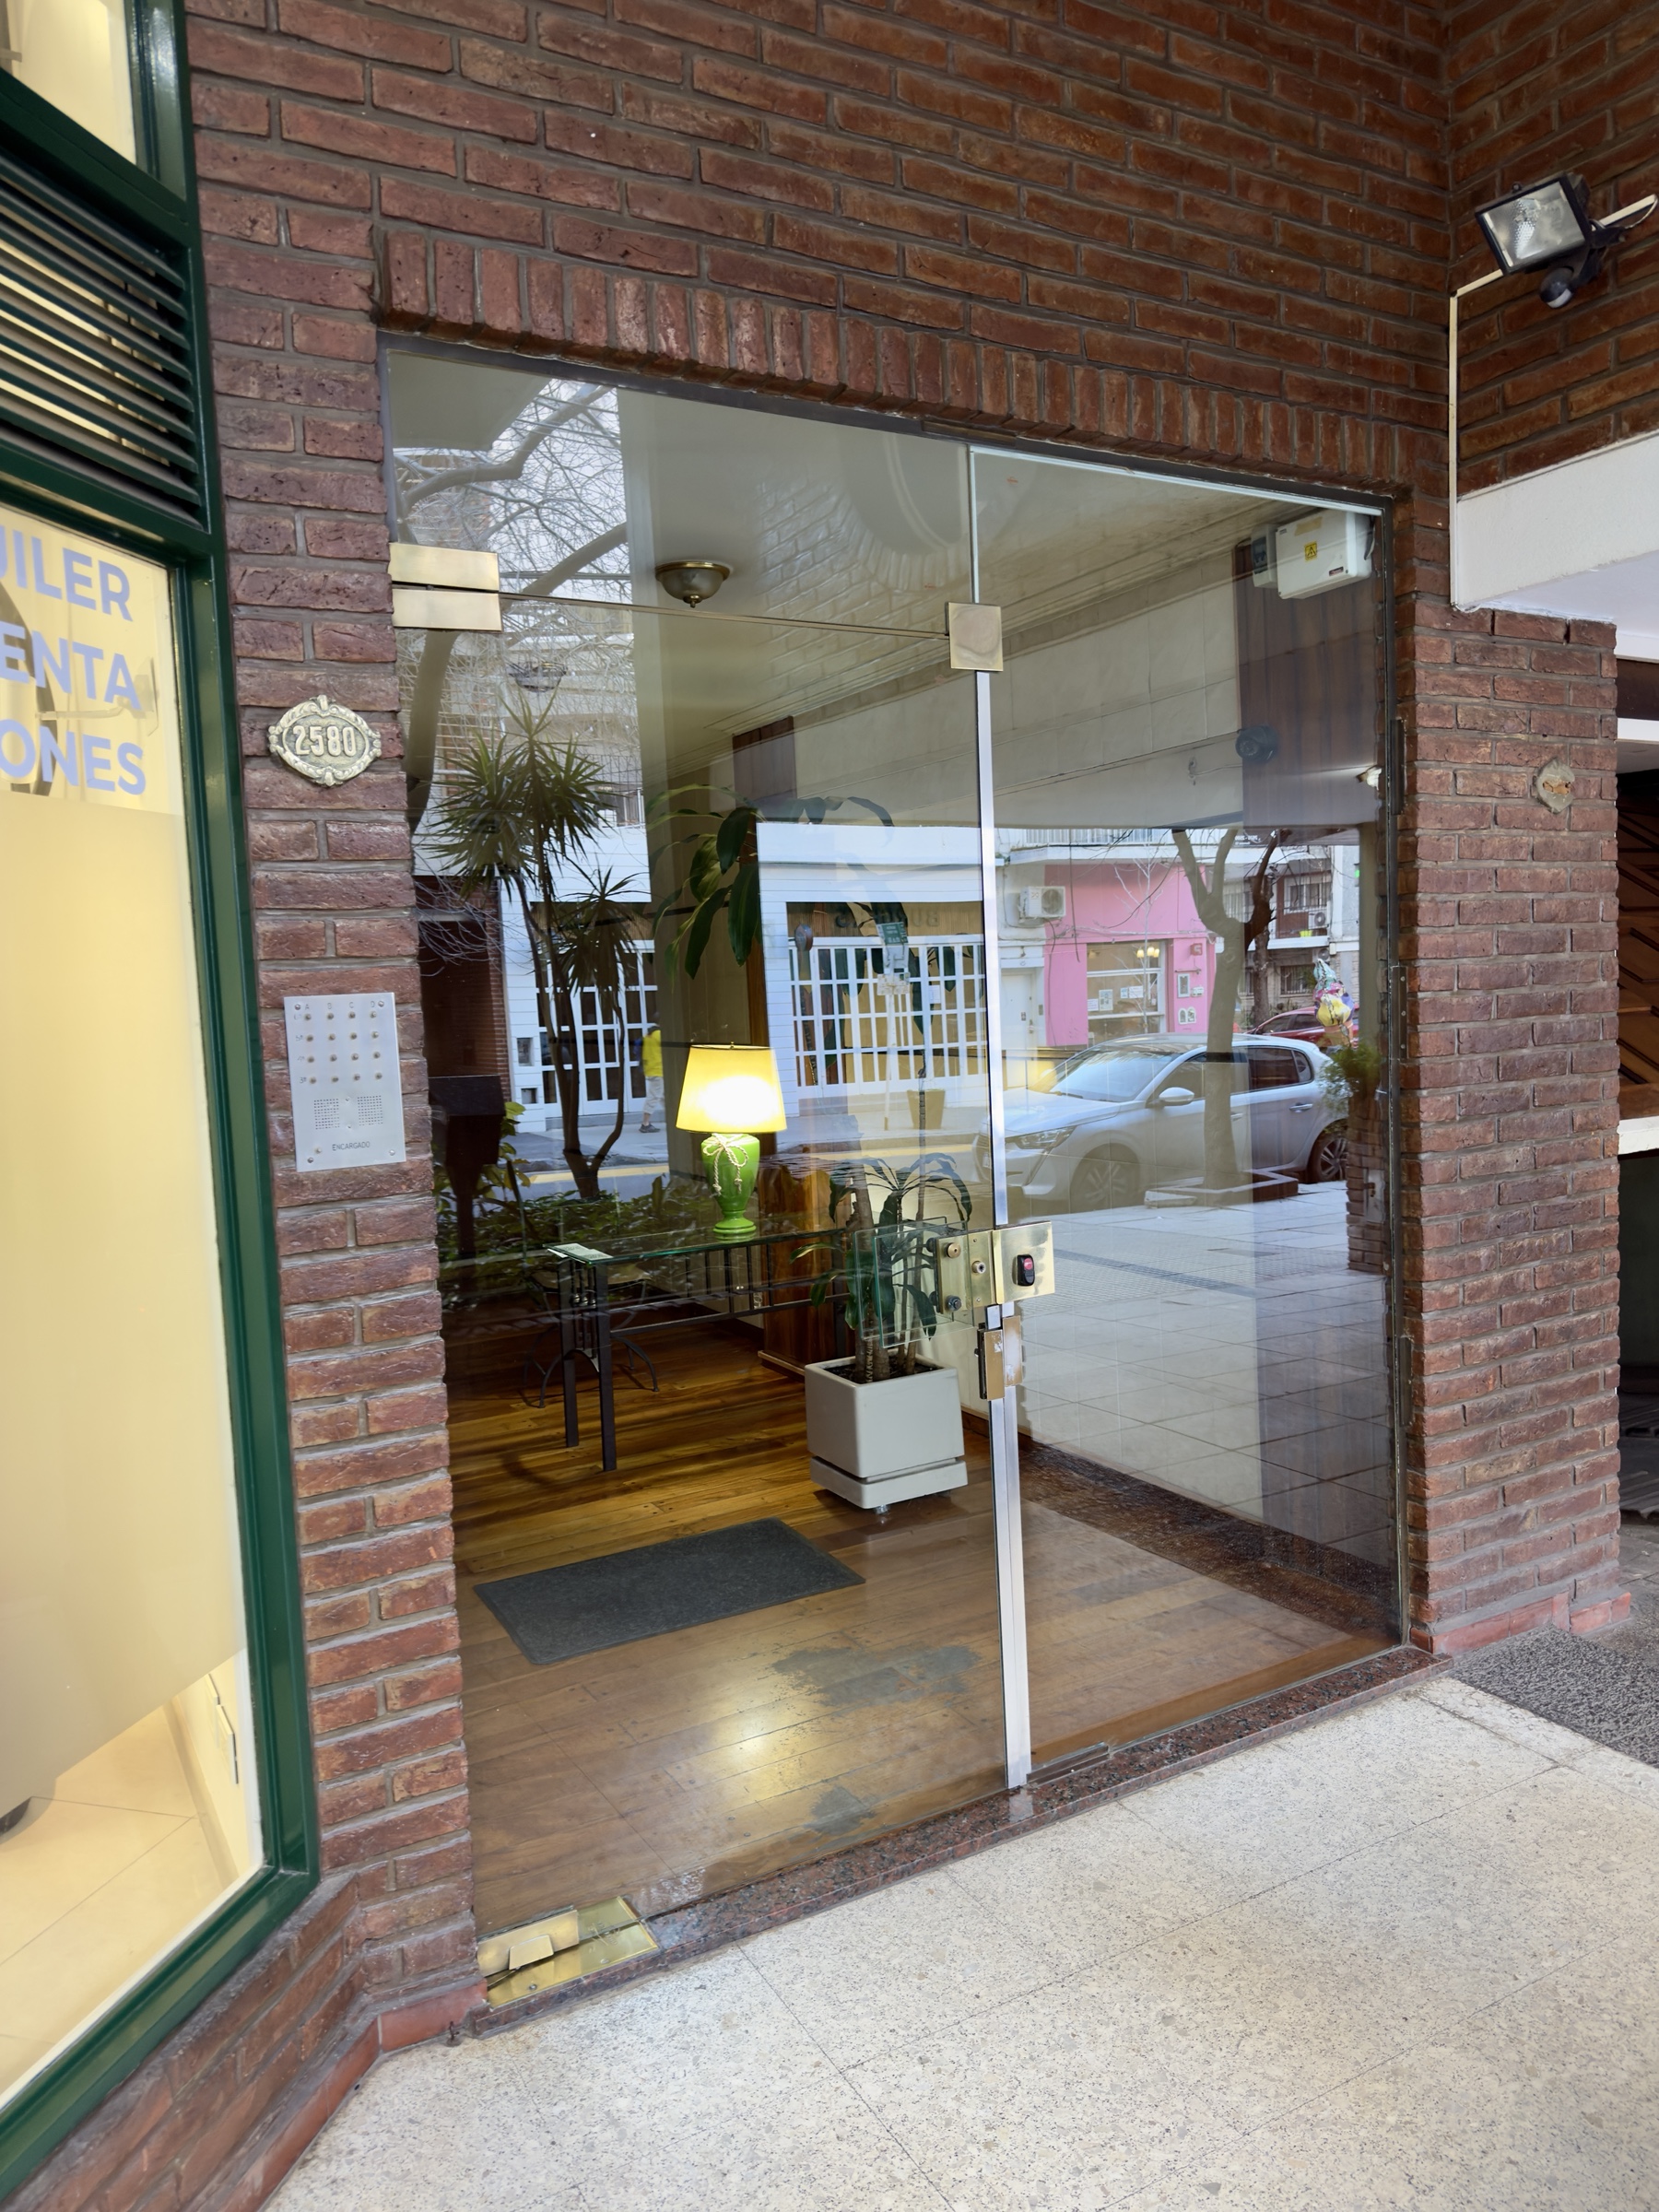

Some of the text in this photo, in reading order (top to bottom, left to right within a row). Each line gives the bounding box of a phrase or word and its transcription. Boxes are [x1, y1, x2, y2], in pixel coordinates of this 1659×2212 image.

[0, 718, 146, 795] ONES
[292, 724, 357, 757] 2580
[332, 1141, 371, 1151] ENCARGADO
